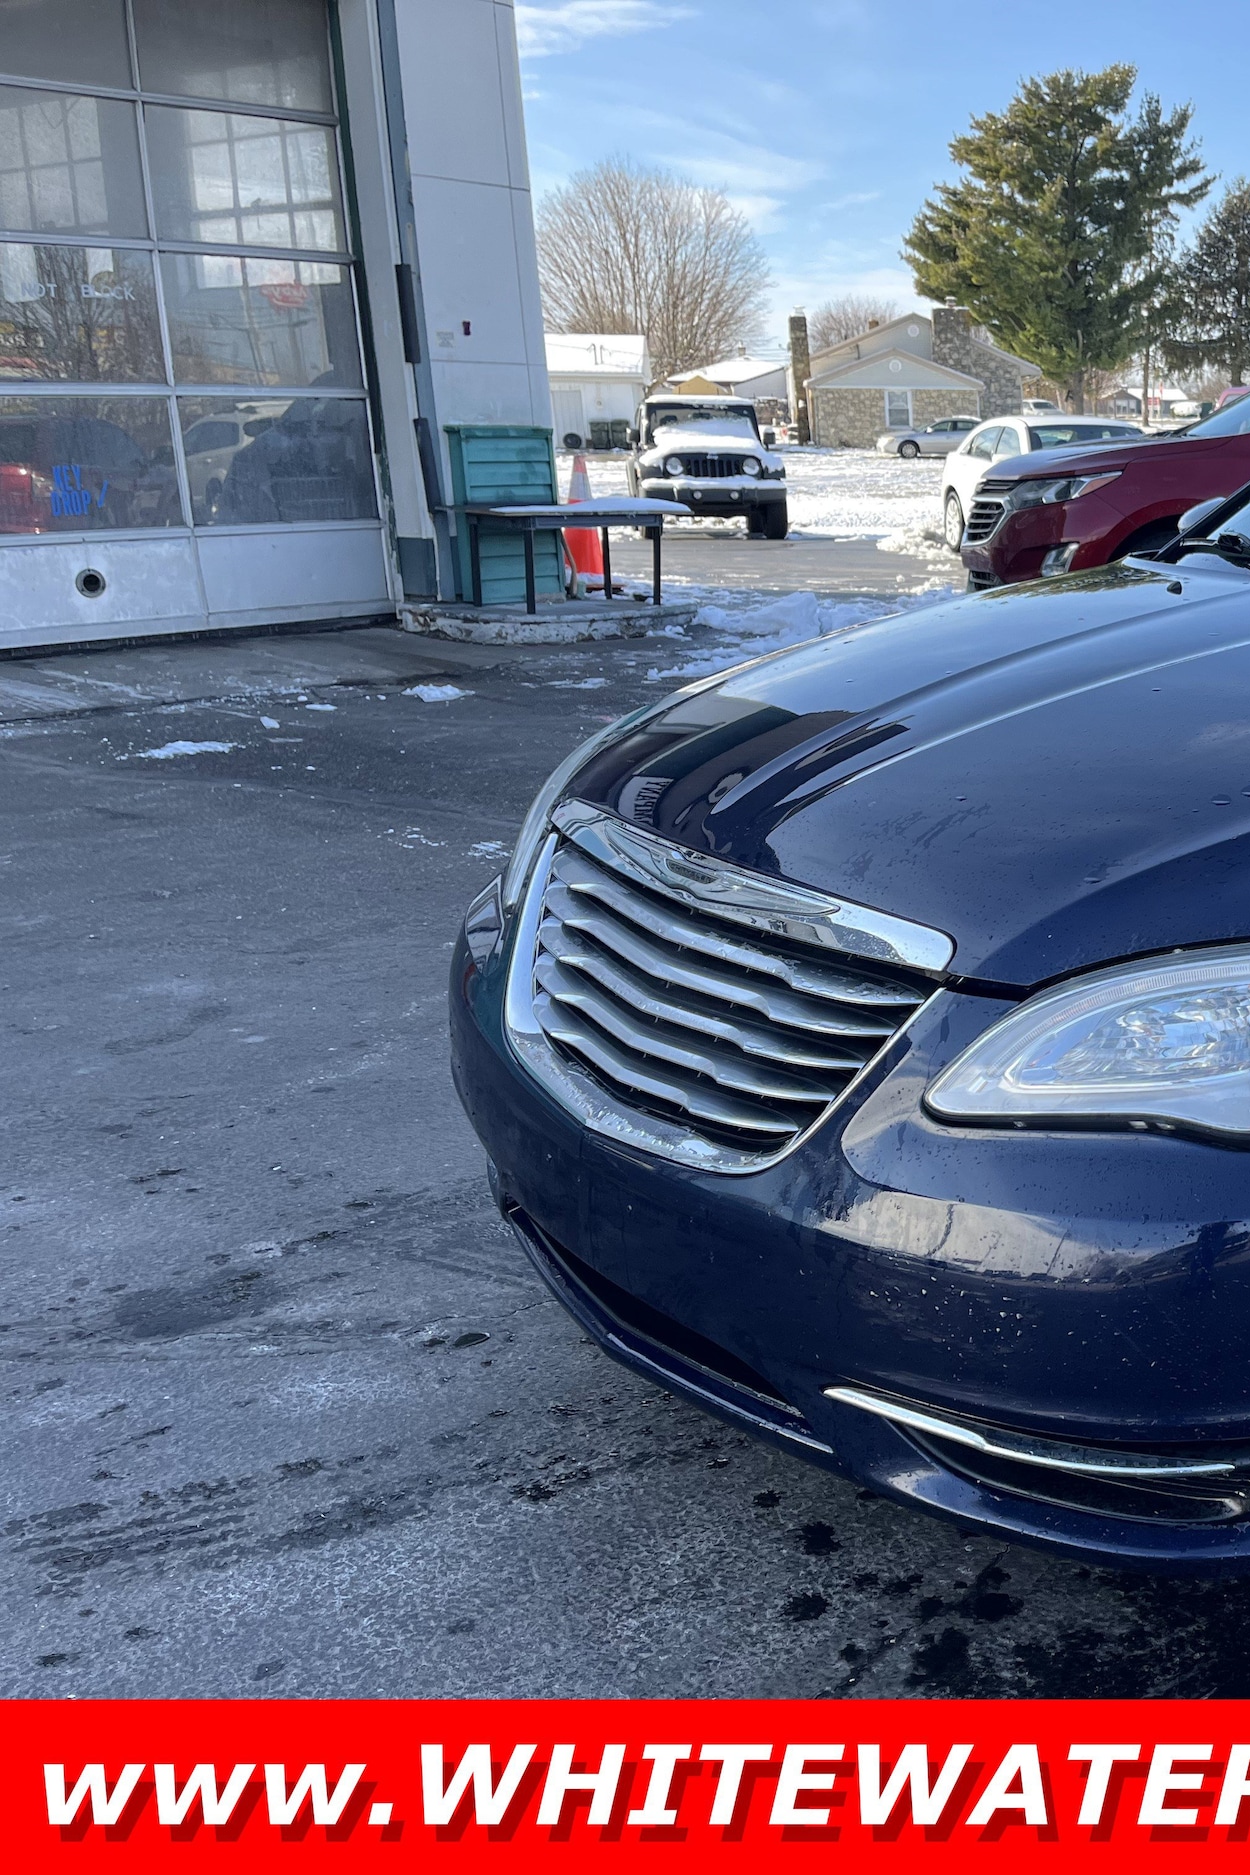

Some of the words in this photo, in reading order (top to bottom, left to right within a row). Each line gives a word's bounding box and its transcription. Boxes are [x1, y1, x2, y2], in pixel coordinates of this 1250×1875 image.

[21, 283, 58, 298] NOT
[80, 283, 136, 300] BLOCK
[52, 464, 80, 491] KEY
[51, 490, 91, 517] DROP
